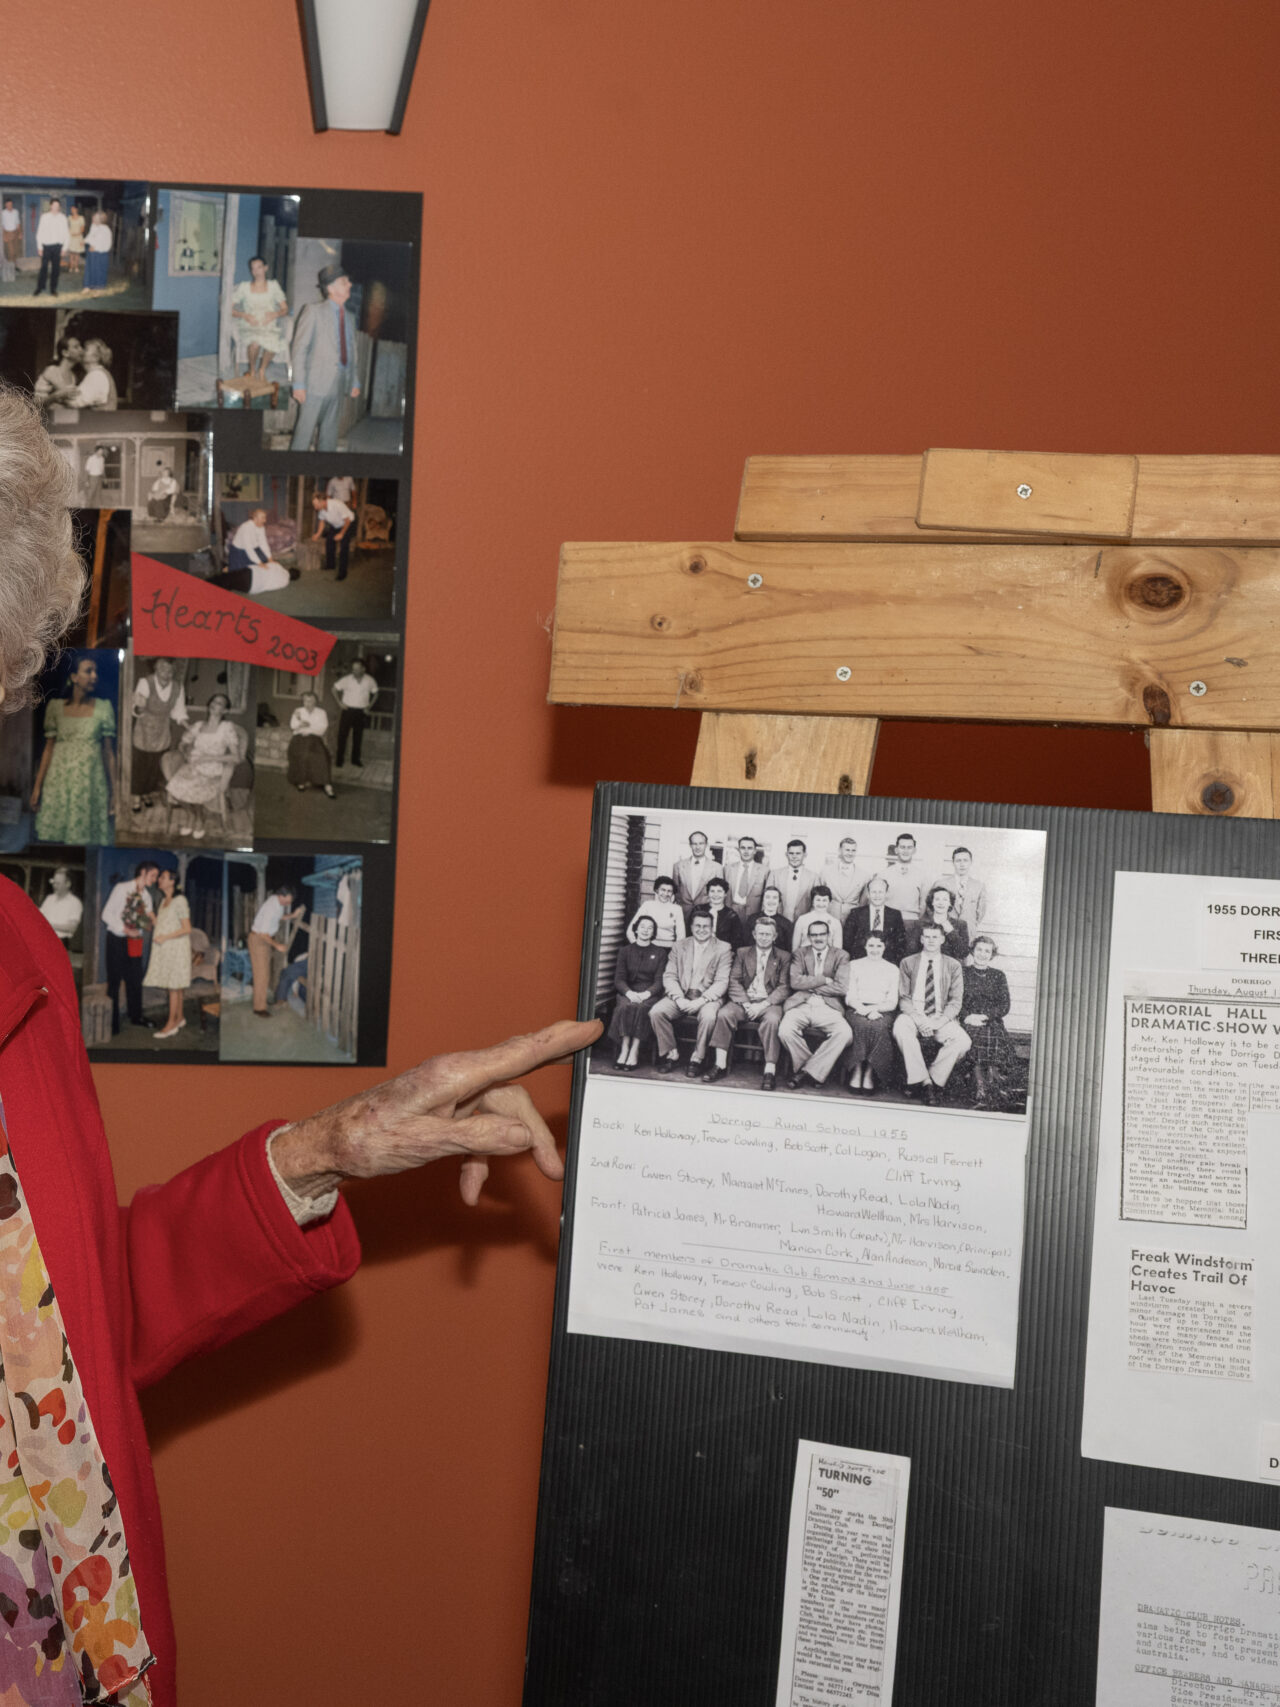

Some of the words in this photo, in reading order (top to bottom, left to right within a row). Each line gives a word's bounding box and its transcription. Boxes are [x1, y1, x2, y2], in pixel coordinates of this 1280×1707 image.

[141, 586, 261, 643] Hearts
[267, 636, 318, 670] 2003
[1207, 904, 1236, 915] 1955
[1240, 952, 1280, 964] THRE
[1231, 978, 1271, 986] DORRIGO
[1188, 984, 1231, 996] Thursday,
[1235, 987, 1267, 998] August
[1130, 1003, 1212, 1017] MEMORIAL
[1227, 1007, 1268, 1020] HALL
[1130, 1017, 1212, 1032] DRAMATIC
[1216, 1021, 1268, 1035] SHOW
[1141, 1035, 1156, 1043] Mr.
[1162, 1035, 1179, 1044] Ken
[1184, 1036, 1225, 1049] Holloway
[1230, 1039, 1237, 1048] is
[1241, 1040, 1252, 1048] to
[1257, 1040, 1269, 1049] be
[1130, 1043, 1183, 1055] directorship
[1190, 1047, 1200, 1055] of
[1208, 1047, 1222, 1056] the
[1230, 1049, 1265, 1060] Dorrigo
[1130, 1055, 1160, 1065] staged
[1164, 1056, 1184, 1065] their
[1189, 1056, 1206, 1065] first
[1210, 1058, 1232, 1067] show
[1252, 1059, 1280, 1069] Tuesd
[710, 1113, 761, 1131] Dorrigo
[775, 1116, 807, 1131] Rural
[816, 1123, 861, 1137] School
[873, 1129, 908, 1141] 1955
[1131, 1249, 1170, 1263] Freak
[1174, 1252, 1253, 1271] Windstorm
[1131, 1264, 1188, 1281] Creates
[1192, 1269, 1223, 1284] Trail
[1229, 1273, 1248, 1286] Of
[1131, 1279, 1176, 1294] Havoc
[818, 1467, 872, 1486] TURNING
[816, 1486, 840, 1498] "50"
[1136, 1647, 1189, 1661] Australia.
